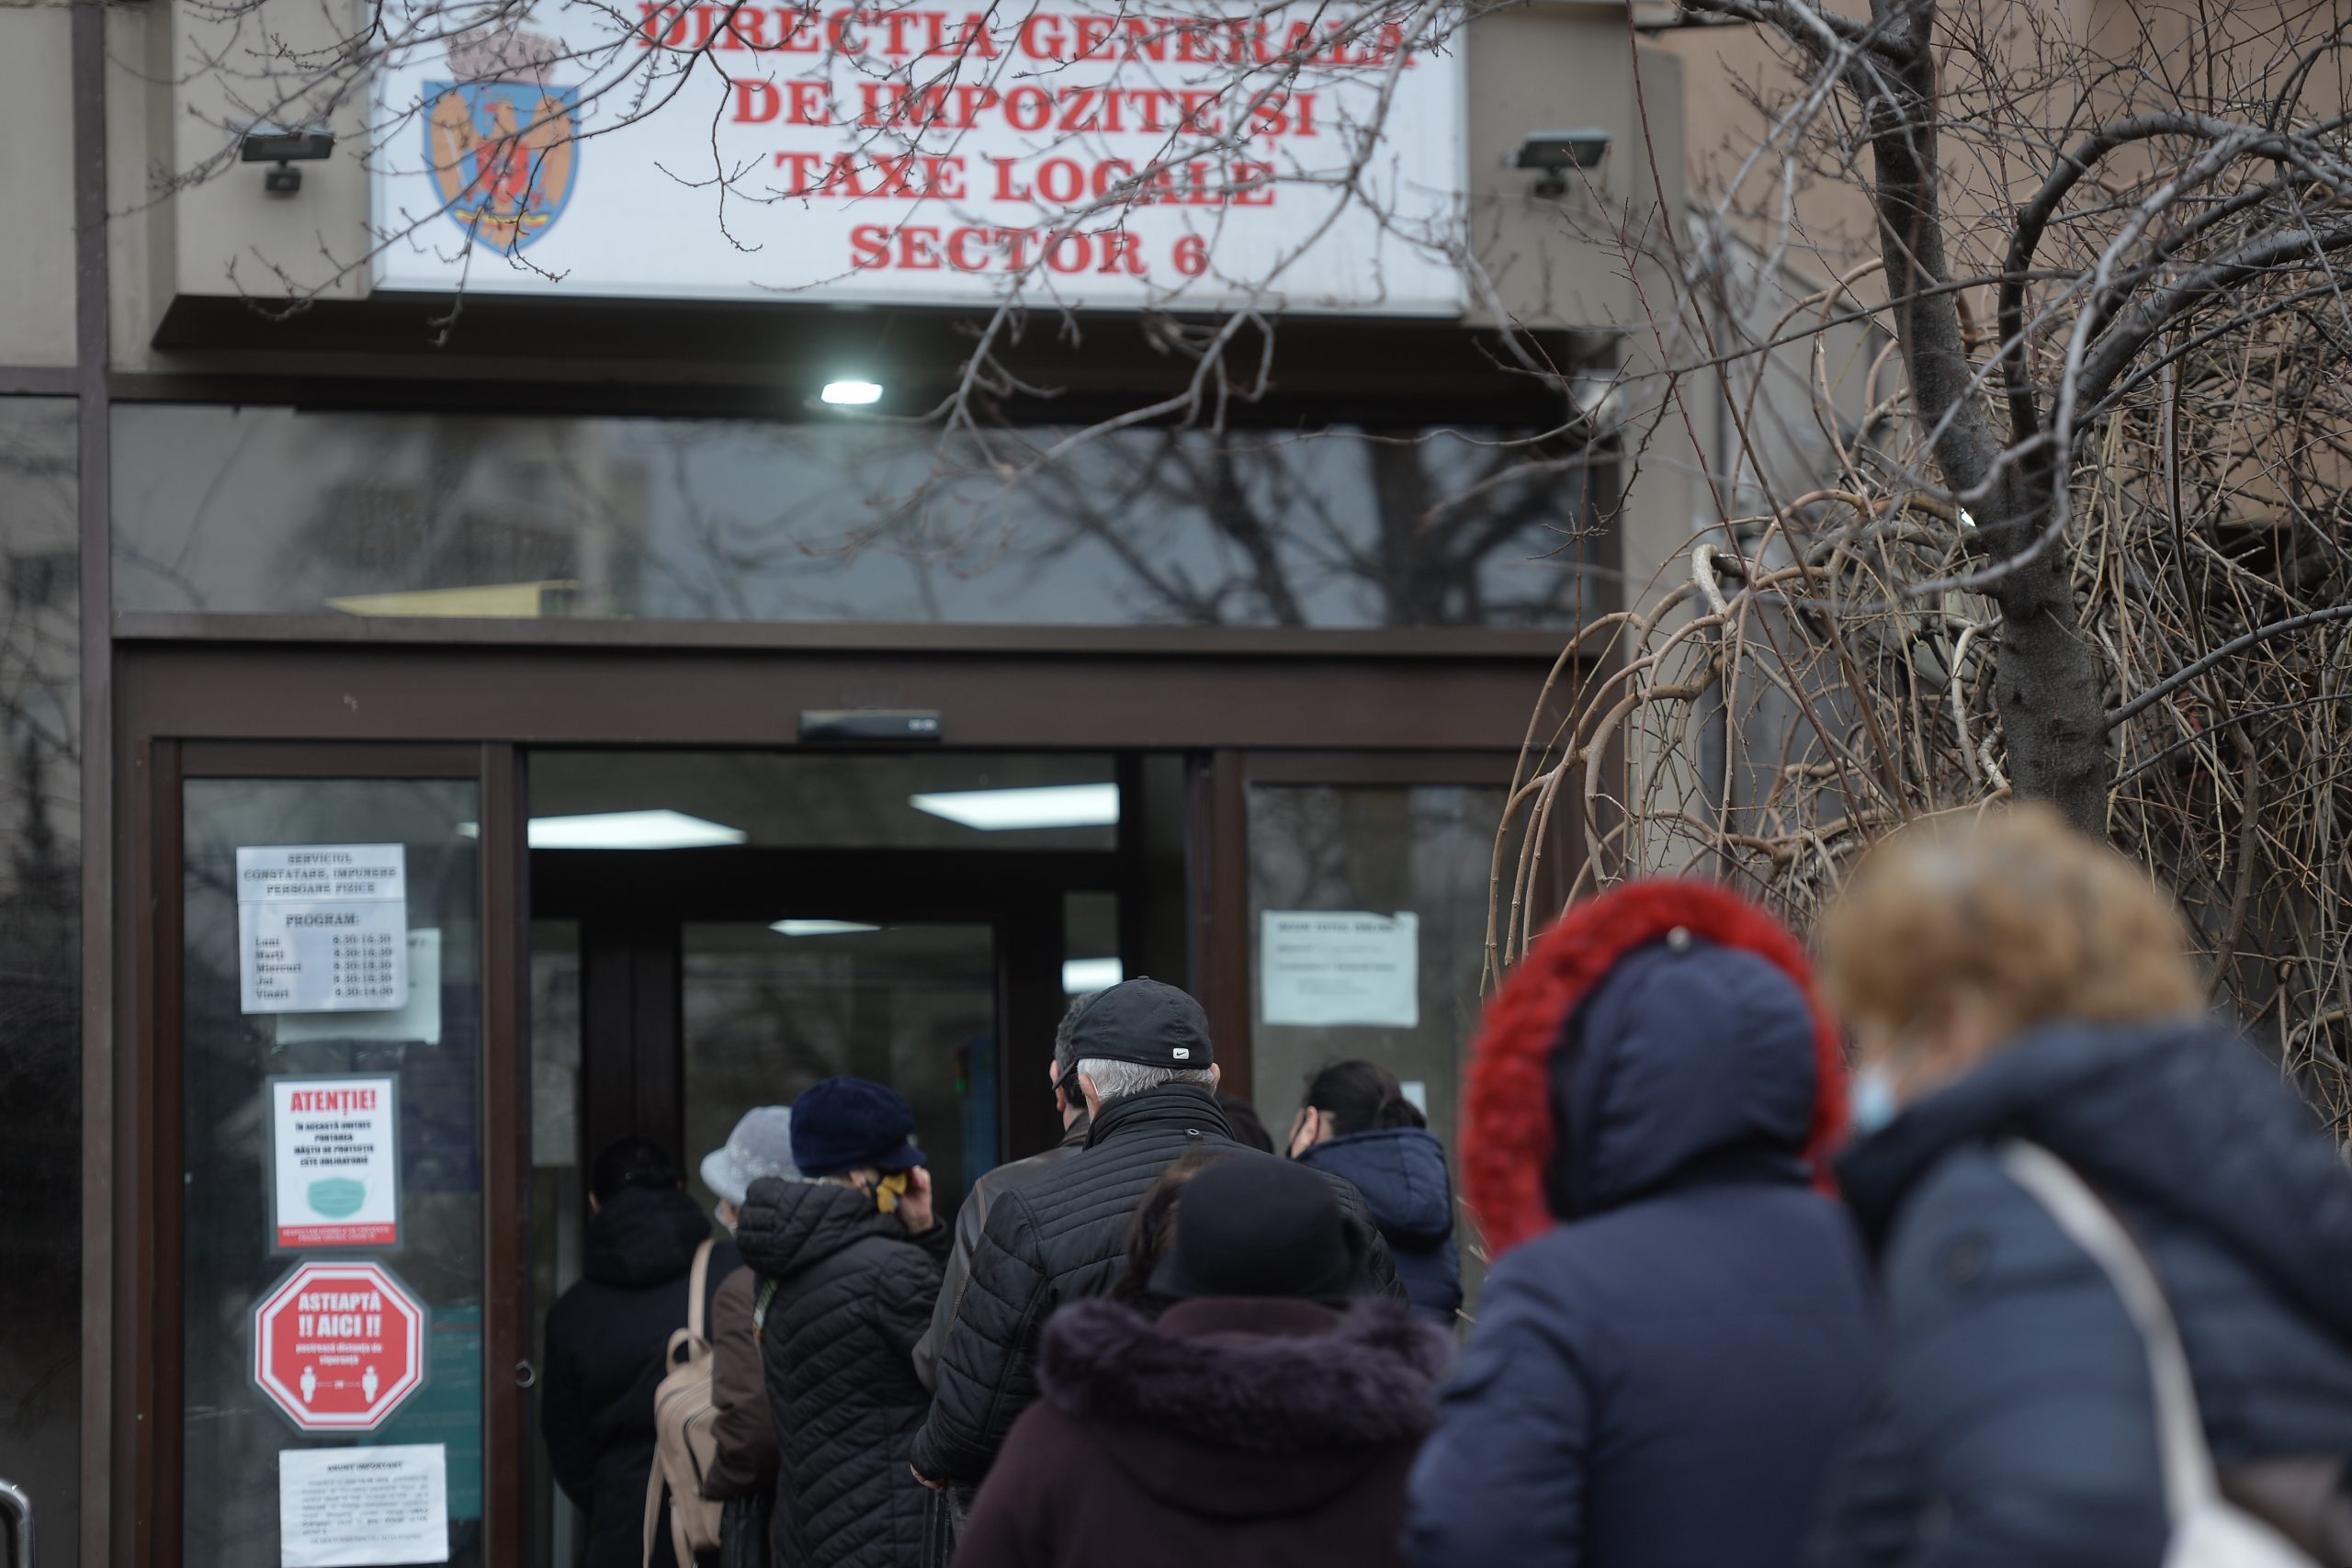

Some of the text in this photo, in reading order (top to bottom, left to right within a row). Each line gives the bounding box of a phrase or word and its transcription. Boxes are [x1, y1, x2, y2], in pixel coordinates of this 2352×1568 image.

[732, 79, 831, 125] DE
[857, 83, 1222, 135] IMPOZITE
[777, 152, 1277, 206] TAXE LOCALE
[851, 224, 1208, 276] SECTOR 6
[288, 852, 352, 866] SERVICIUL
[333, 866, 398, 879] IMPUNERE
[266, 881, 376, 895] PERSOANE FIZICE
[255, 936, 280, 947] Luni
[289, 1088, 377, 1116] ATENȚIE!
[317, 1314, 362, 1337] AICI
